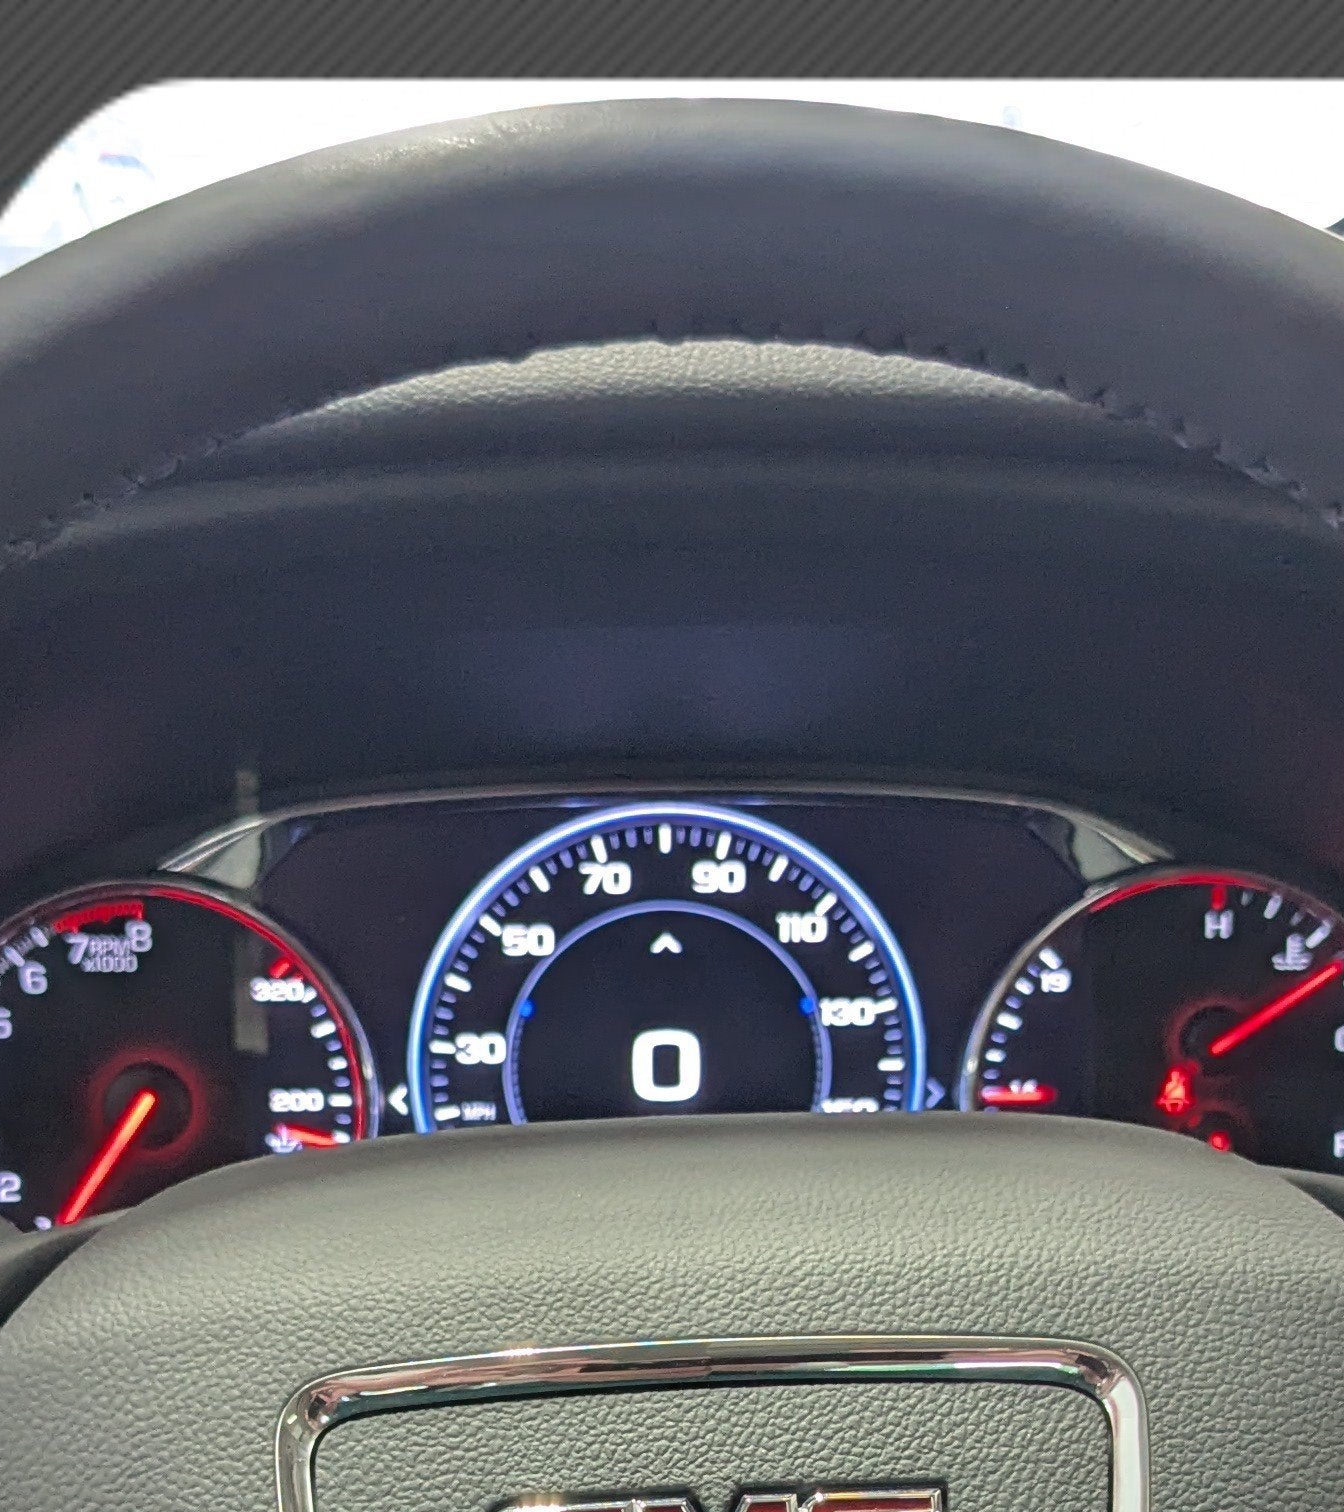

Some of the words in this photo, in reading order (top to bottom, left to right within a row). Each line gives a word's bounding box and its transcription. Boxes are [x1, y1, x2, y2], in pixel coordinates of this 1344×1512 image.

[579, 862, 632, 895] 70
[692, 861, 746, 894] 90
[125, 921, 152, 952] 8
[777, 912, 828, 945] 110
[1204, 909, 1234, 940] H
[65, 933, 88, 964] 7
[501, 925, 555, 958] 50
[19, 962, 47, 995] 6
[1040, 968, 1072, 993] 19
[820, 998, 876, 1027] 130
[455, 1033, 507, 1065] 30
[631, 1029, 703, 1103] 0
[269, 1088, 325, 1113] 200
